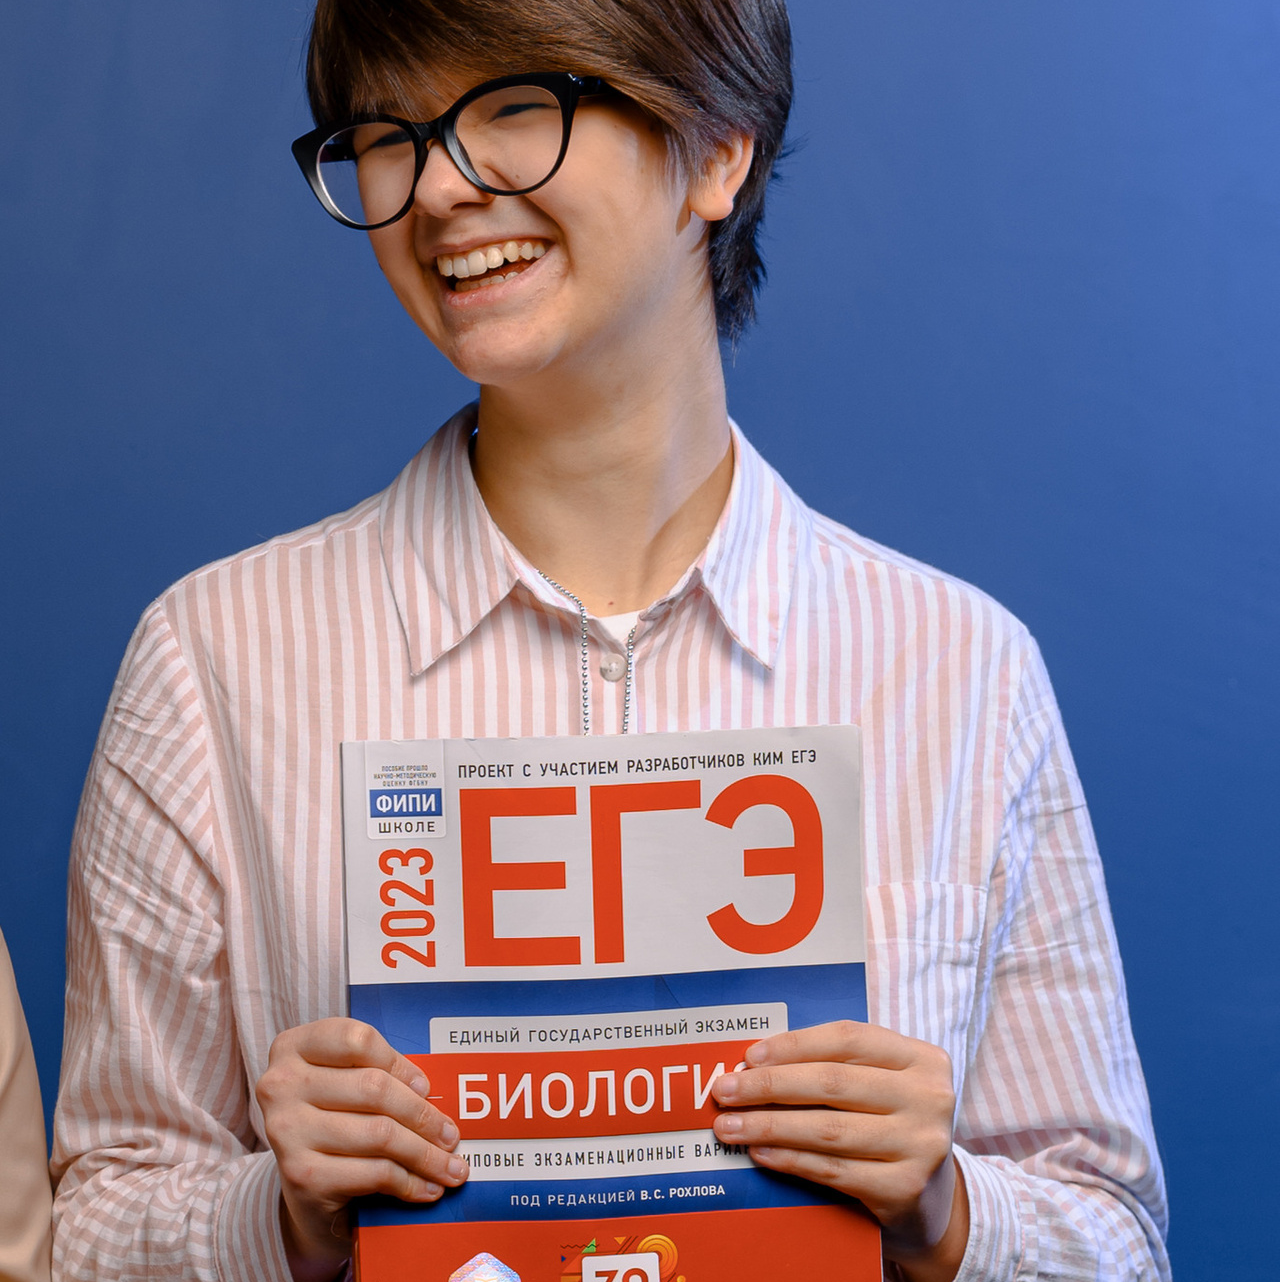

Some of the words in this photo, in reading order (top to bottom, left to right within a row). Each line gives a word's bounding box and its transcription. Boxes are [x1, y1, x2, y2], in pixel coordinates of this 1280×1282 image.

[458, 764, 514, 778] ПРОЕКТ
[523, 763, 531, 777] С
[540, 760, 618, 777] УЧАСТИЕМ
[627, 753, 745, 773] РАЗРАБОТЧИКОВ
[753, 751, 783, 766] КИМ
[791, 749, 817, 764] ЕГЭ
[376, 793, 436, 813] ФИПИ
[379, 821, 435, 834] ШКОЛЕ
[459, 773, 825, 967] ЕГЭ
[378, 847, 436, 969] 2023
[449, 1027, 520, 1046] ЕДИНЫЙ
[528, 1019, 689, 1043] ГОСУДАРСТВЕННЫЙ
[695, 1016, 770, 1033] ЭКЗАМЕН
[457, 1061, 747, 1121] БИОЛОГИ
[463, 1153, 524, 1167] ИПОВЫЕ
[535, 1145, 685, 1167] ЭКЗАМЕНАЦИОННЫЕ
[694, 1143, 750, 1158] ВАРИА
[510, 1194, 540, 1206] ПОД
[547, 1190, 635, 1206] РЕДАКЦИЕЙ
[669, 1184, 726, 1199] РОХЛОВА
